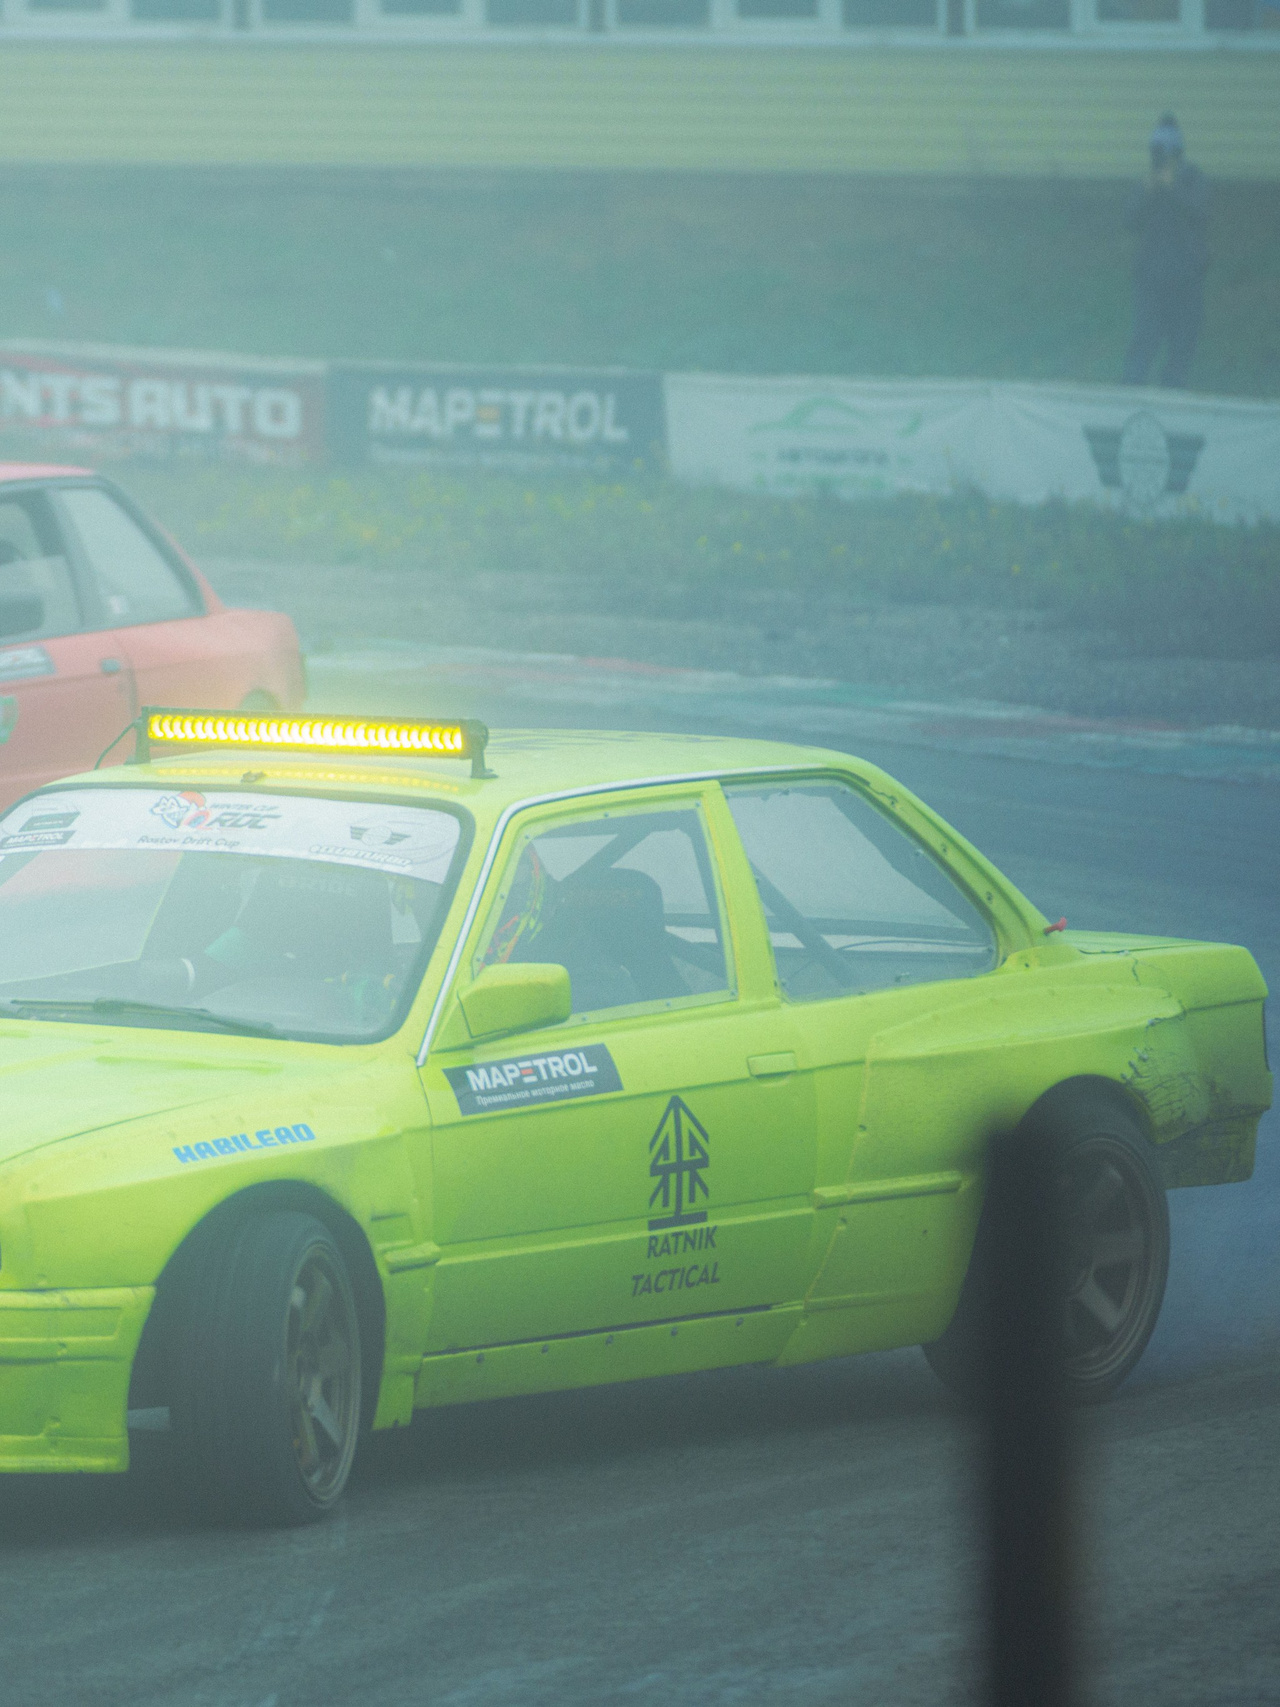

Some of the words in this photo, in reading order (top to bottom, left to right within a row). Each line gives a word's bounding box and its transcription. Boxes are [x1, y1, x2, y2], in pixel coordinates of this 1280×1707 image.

[128, 379, 302, 438] AUTO
[368, 385, 629, 441] MAPETROL
[137, 835, 179, 844] Rostov
[181, 836, 213, 846] Drift
[214, 837, 241, 848] Cup
[466, 1052, 598, 1091] MAPETROL
[476, 1090, 531, 1106] Премиальное
[532, 1083, 569, 1096] моторное
[570, 1079, 595, 1090] масло
[172, 1123, 316, 1164] HABILEAD
[647, 1225, 718, 1259] RATNIK
[631, 1262, 720, 1297] TACTICAL
